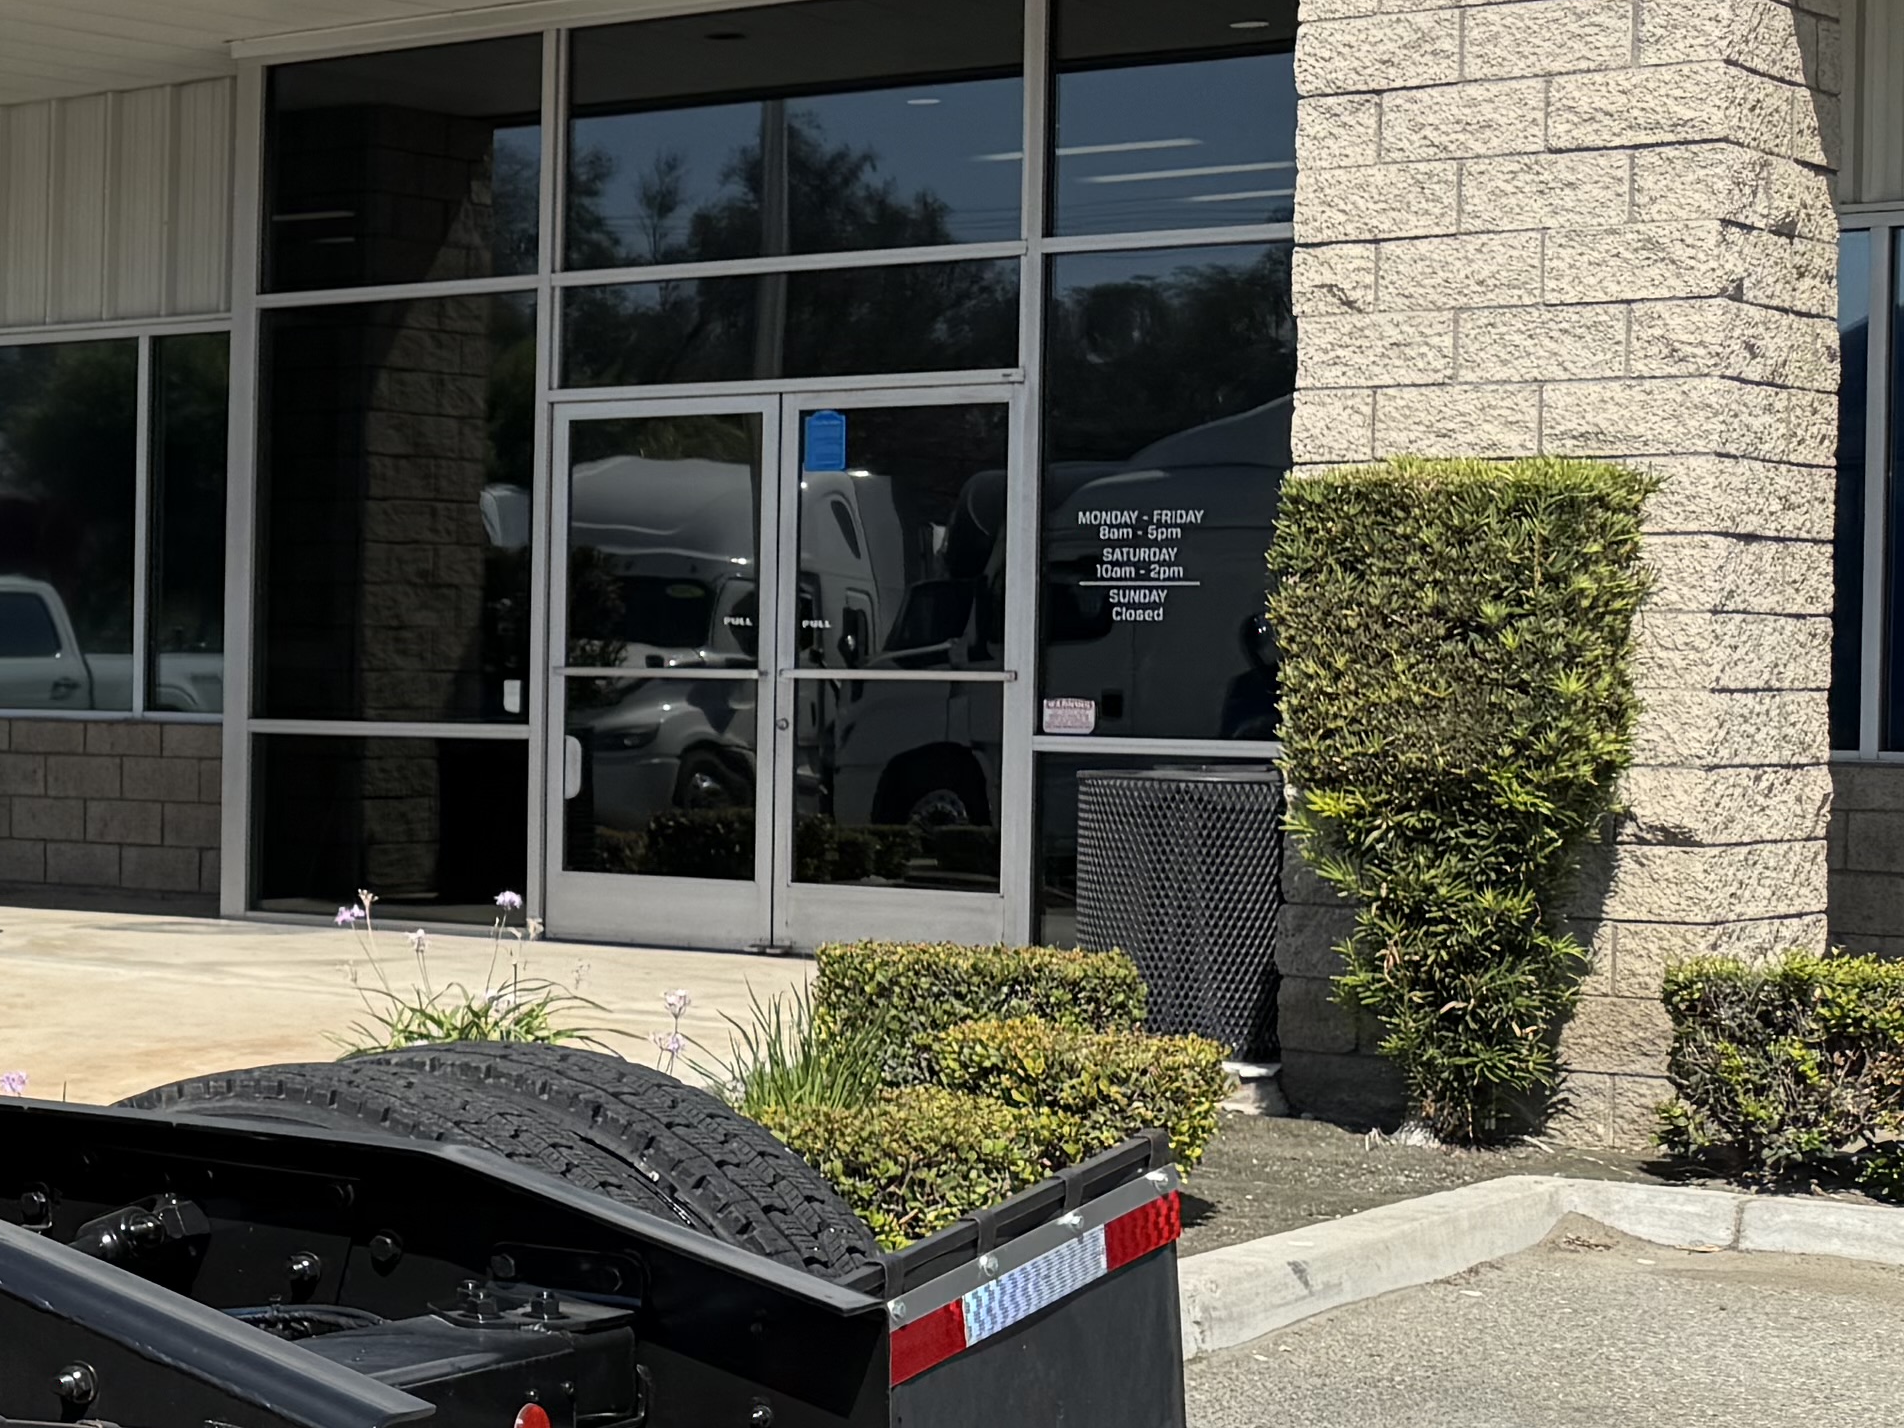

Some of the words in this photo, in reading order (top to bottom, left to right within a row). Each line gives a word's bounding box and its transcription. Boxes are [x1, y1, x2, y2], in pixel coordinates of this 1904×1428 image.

[1078, 510, 1138, 524] MONDAY
[1153, 509, 1204, 523] FRIDAY
[1099, 525, 1132, 539] 8am
[1148, 525, 1181, 541] 5pm
[1102, 547, 1177, 561] SATURDAY
[1096, 564, 1135, 578] 10am
[1150, 564, 1184, 580] 2pm
[1109, 589, 1167, 603] SUNDAY
[724, 616, 753, 626] PULL
[1112, 607, 1163, 621] Closed
[802, 620, 831, 628] PULL
